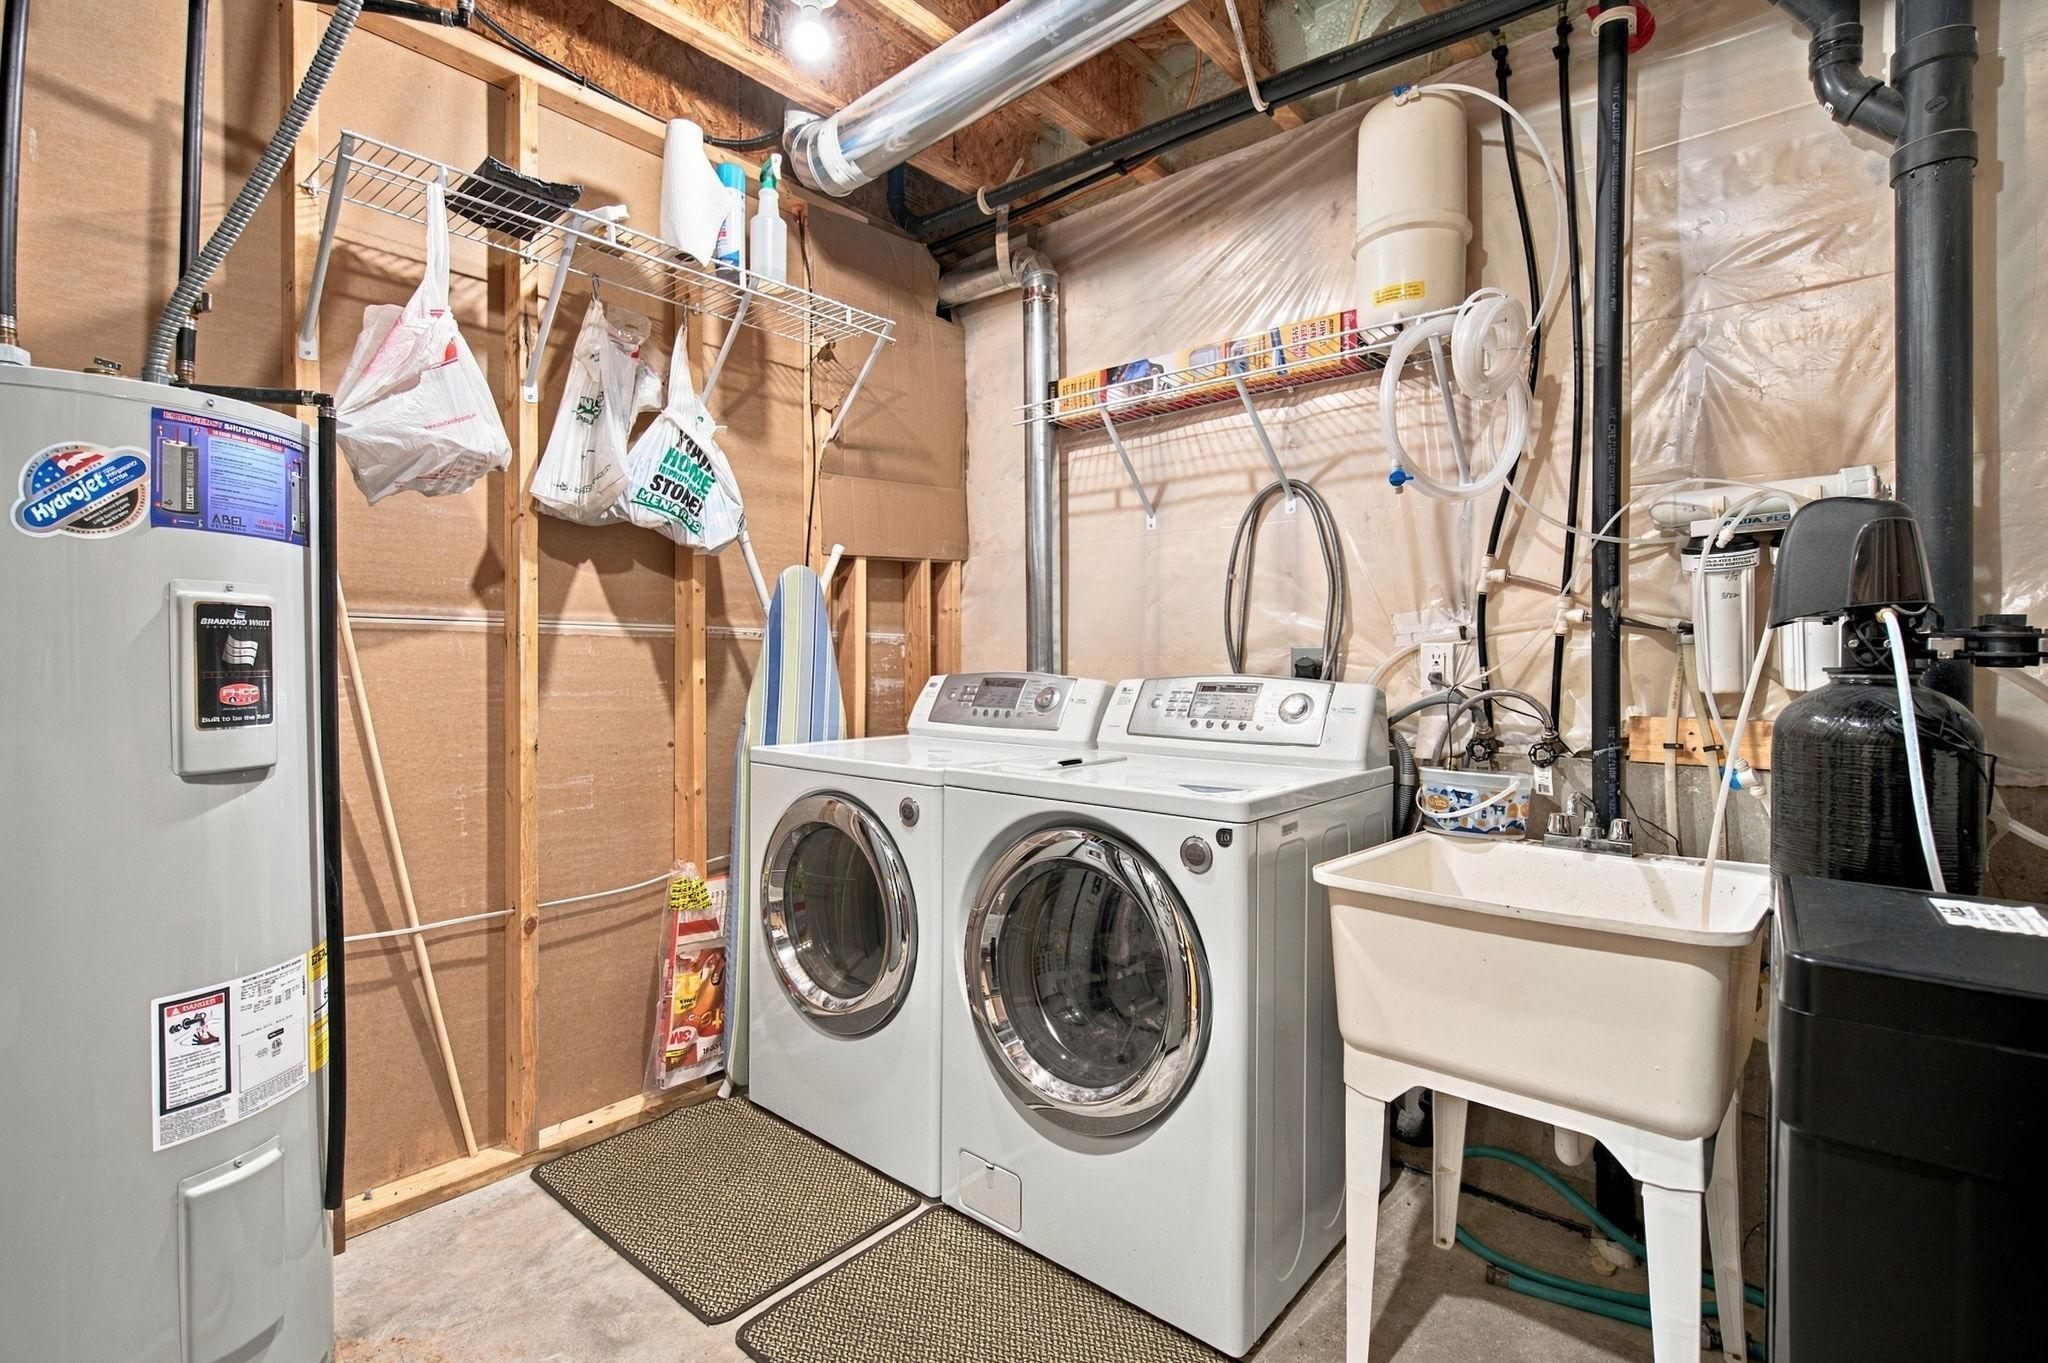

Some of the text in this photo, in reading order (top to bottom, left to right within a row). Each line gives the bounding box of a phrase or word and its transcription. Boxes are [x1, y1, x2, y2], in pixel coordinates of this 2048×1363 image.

[224, 423, 267, 440] SHUTDOWN
[662, 446, 716, 496] HOME
[30, 472, 107, 522] Hydrojet
[650, 474, 703, 517] STORE!
[636, 487, 704, 533] MENARDS
[212, 514, 246, 527] ABEL
[200, 617, 271, 627] BRADFORD WHITE
[244, 713, 256, 721] the
[182, 996, 217, 1013] DANGER
[669, 1029, 692, 1045] 3M
